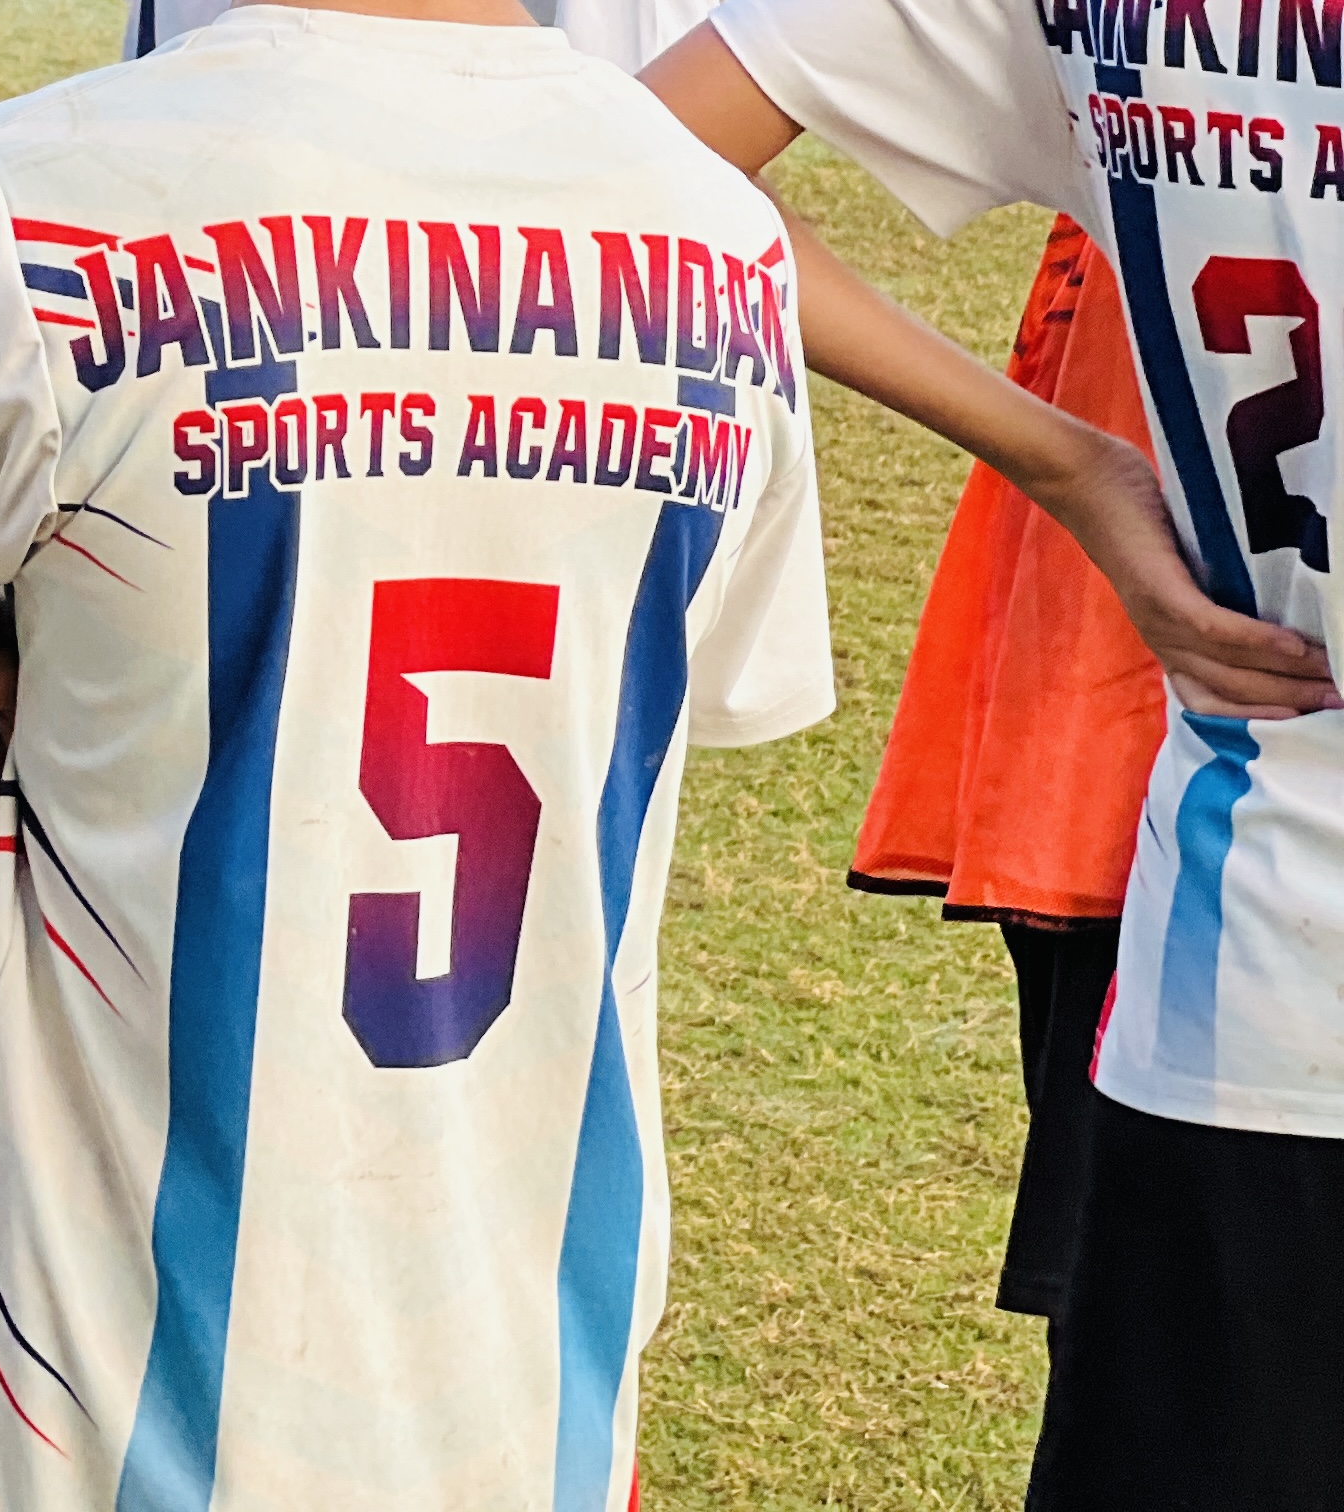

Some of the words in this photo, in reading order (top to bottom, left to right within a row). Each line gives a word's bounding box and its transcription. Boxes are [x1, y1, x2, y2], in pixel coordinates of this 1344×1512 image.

[1089, 93, 1285, 193] SPORTS
[70, 215, 796, 414] JANKINANDAN
[174, 392, 436, 497] SPORTS
[458, 394, 753, 510] ACADEMY
[342, 577, 560, 1069] 5
